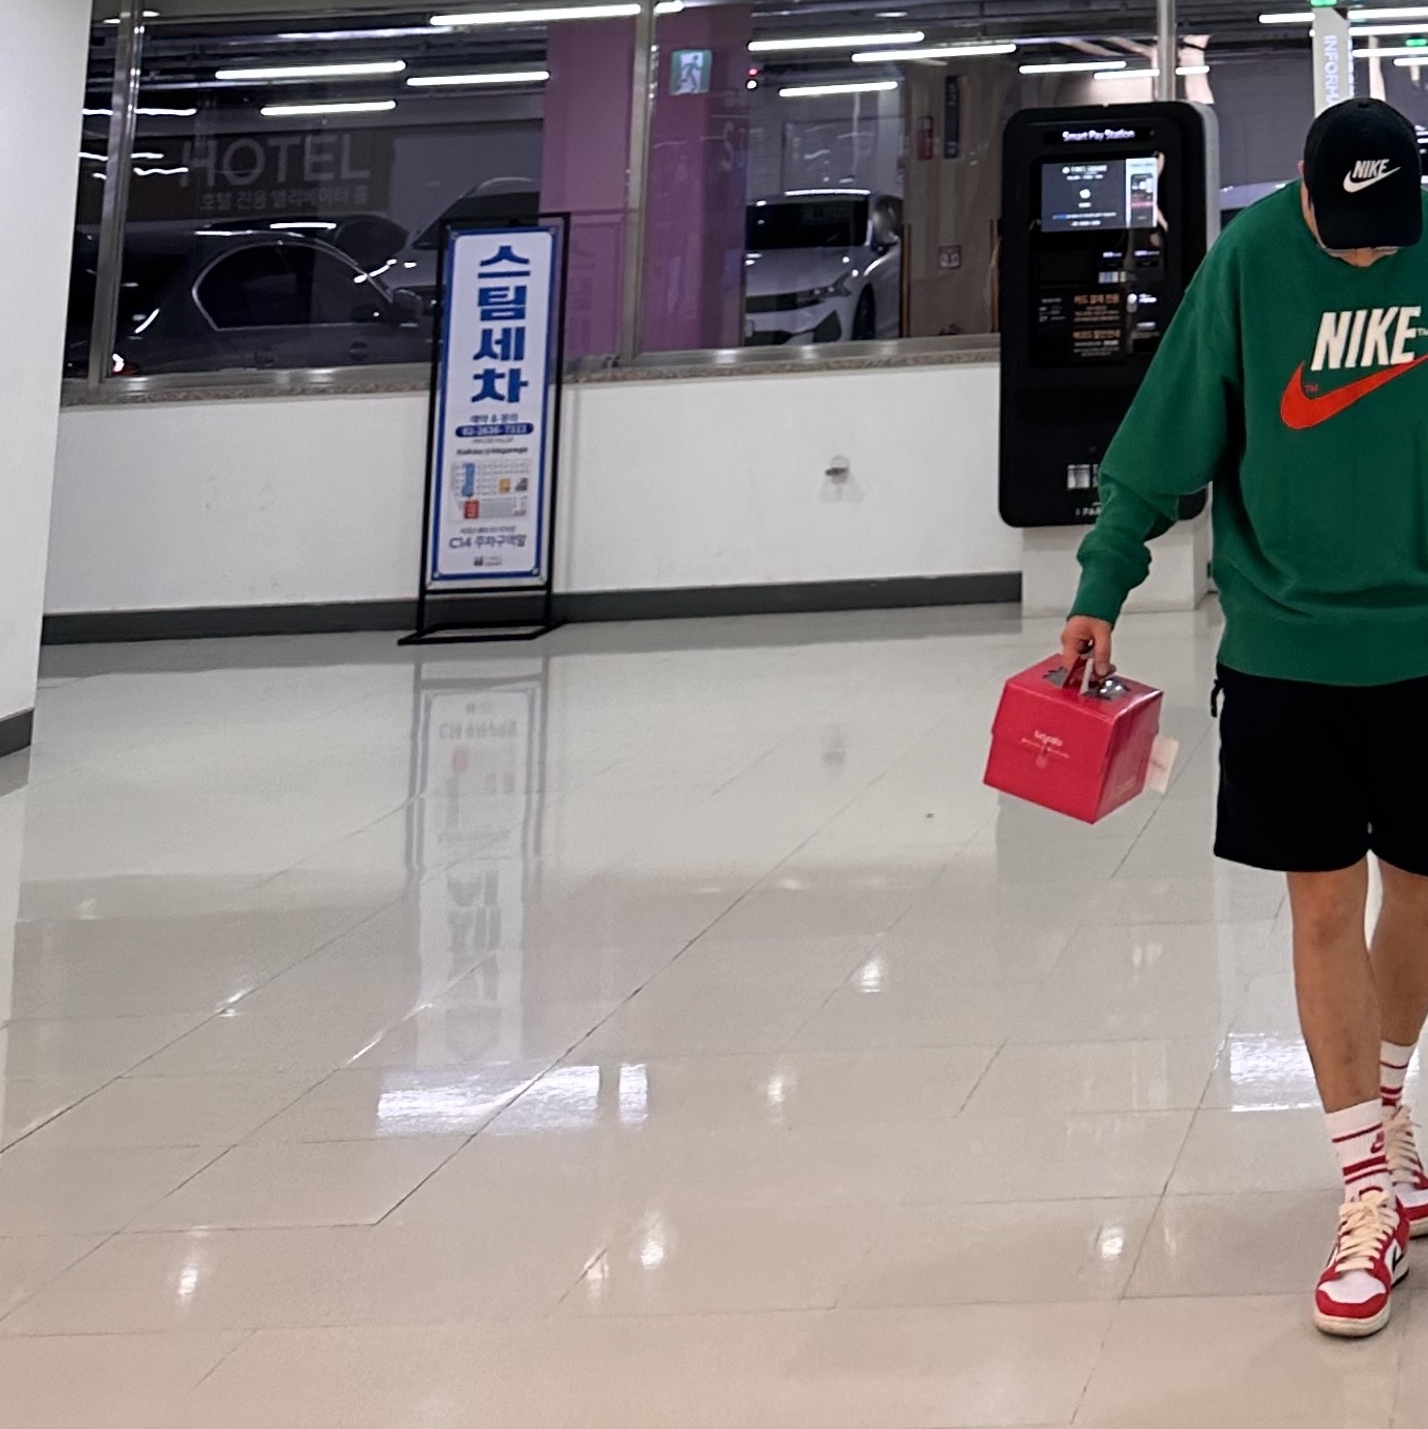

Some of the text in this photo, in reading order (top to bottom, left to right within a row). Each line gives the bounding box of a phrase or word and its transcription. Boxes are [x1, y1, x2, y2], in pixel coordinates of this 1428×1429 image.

[179, 133, 371, 187] HOTEL
[1062, 128, 1136, 142] Smart Pay Station
[1352, 158, 1390, 179] NIKE
[471, 245, 531, 404] 스팀세차
[1311, 306, 1422, 371] NIKE
